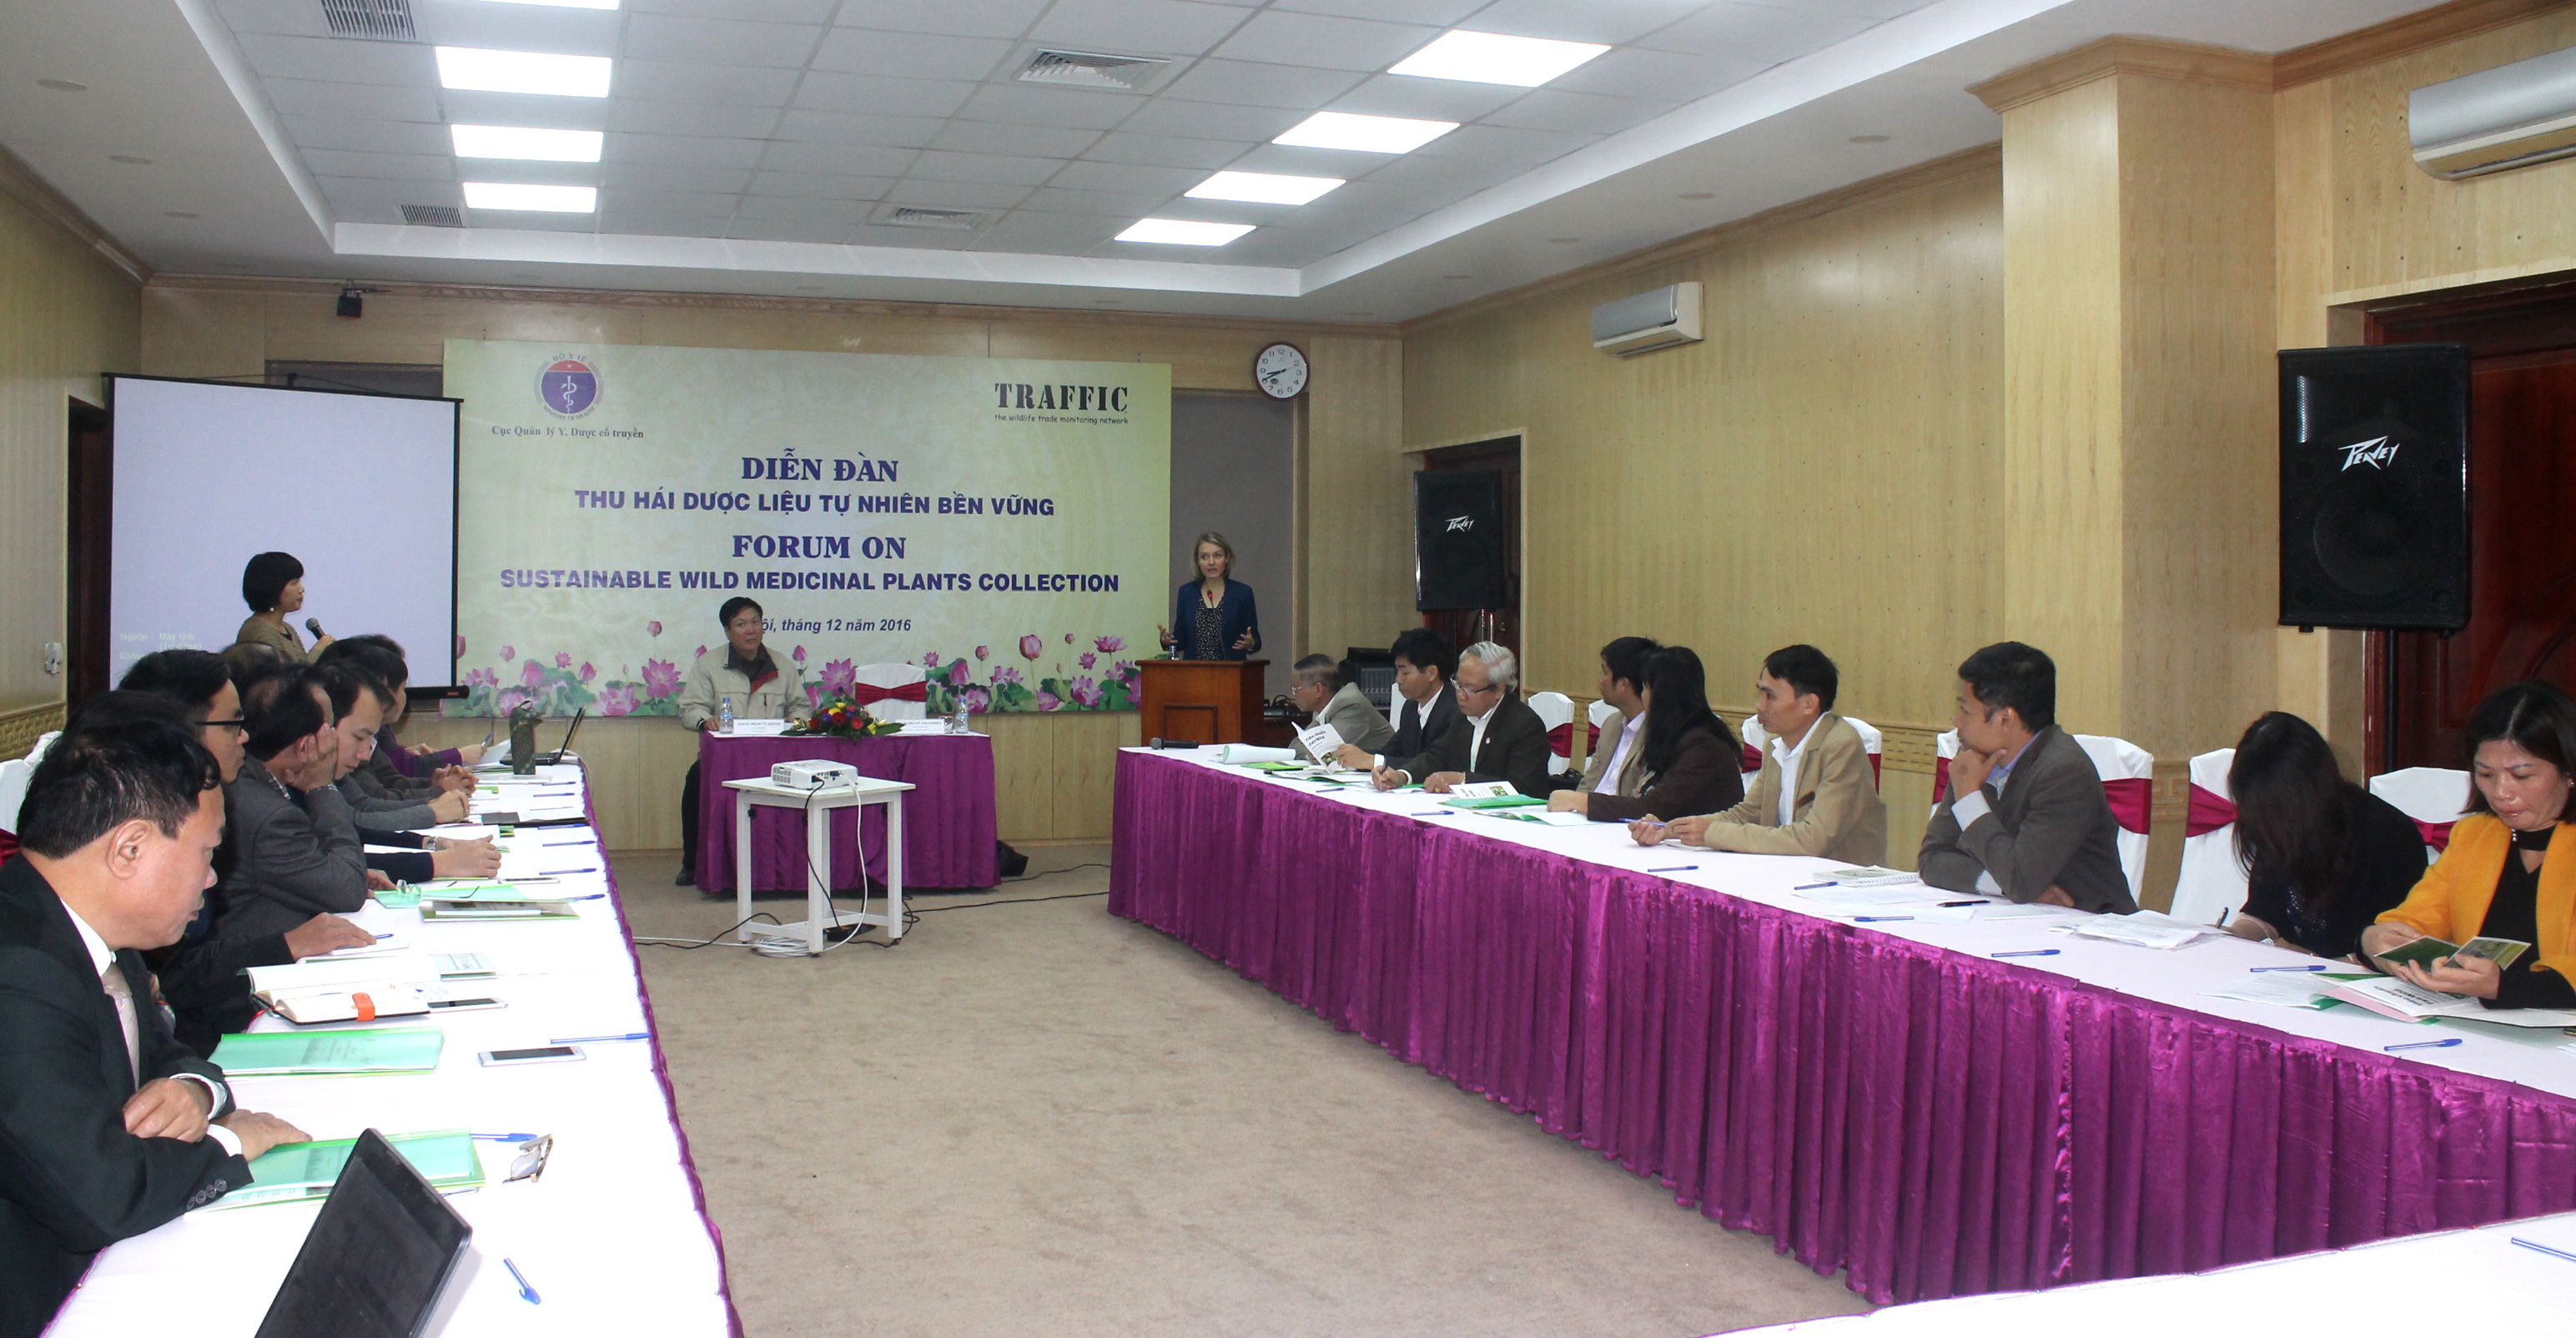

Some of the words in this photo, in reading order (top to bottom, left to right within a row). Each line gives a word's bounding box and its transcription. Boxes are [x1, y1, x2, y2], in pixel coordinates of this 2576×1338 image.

[994, 383, 1128, 412] TRAFFIC
[576, 406, 595, 420] HEALTH
[1060, 416, 1098, 425] monitoring
[491, 425, 511, 437] Cục
[571, 427, 596, 439] Dược
[612, 426, 644, 440] truyền
[742, 448, 823, 481] DIỄN
[834, 452, 898, 482] ĐÀN
[575, 490, 625, 509] THU
[634, 487, 675, 510] HÁI
[683, 490, 751, 515] DƯỢC
[758, 490, 811, 516] LIỆU
[819, 494, 851, 516] TỰ
[858, 493, 930, 514] NHIÊN
[938, 491, 983, 515] BỀN
[992, 494, 1054, 516] VỮNG
[732, 536, 850, 559] FORUM
[862, 536, 907, 559] ON
[501, 569, 672, 589] SUSTAINABLE
[680, 571, 739, 590] WILD
[747, 571, 875, 591] MEDICINAL
[883, 573, 972, 591] PLANTS
[979, 574, 1119, 592] COLLECTION
[762, 619, 777, 634] ội,
[782, 618, 822, 634] tháng
[827, 619, 842, 631] 12
[846, 619, 875, 631] năm
[879, 619, 912, 631] 2016
